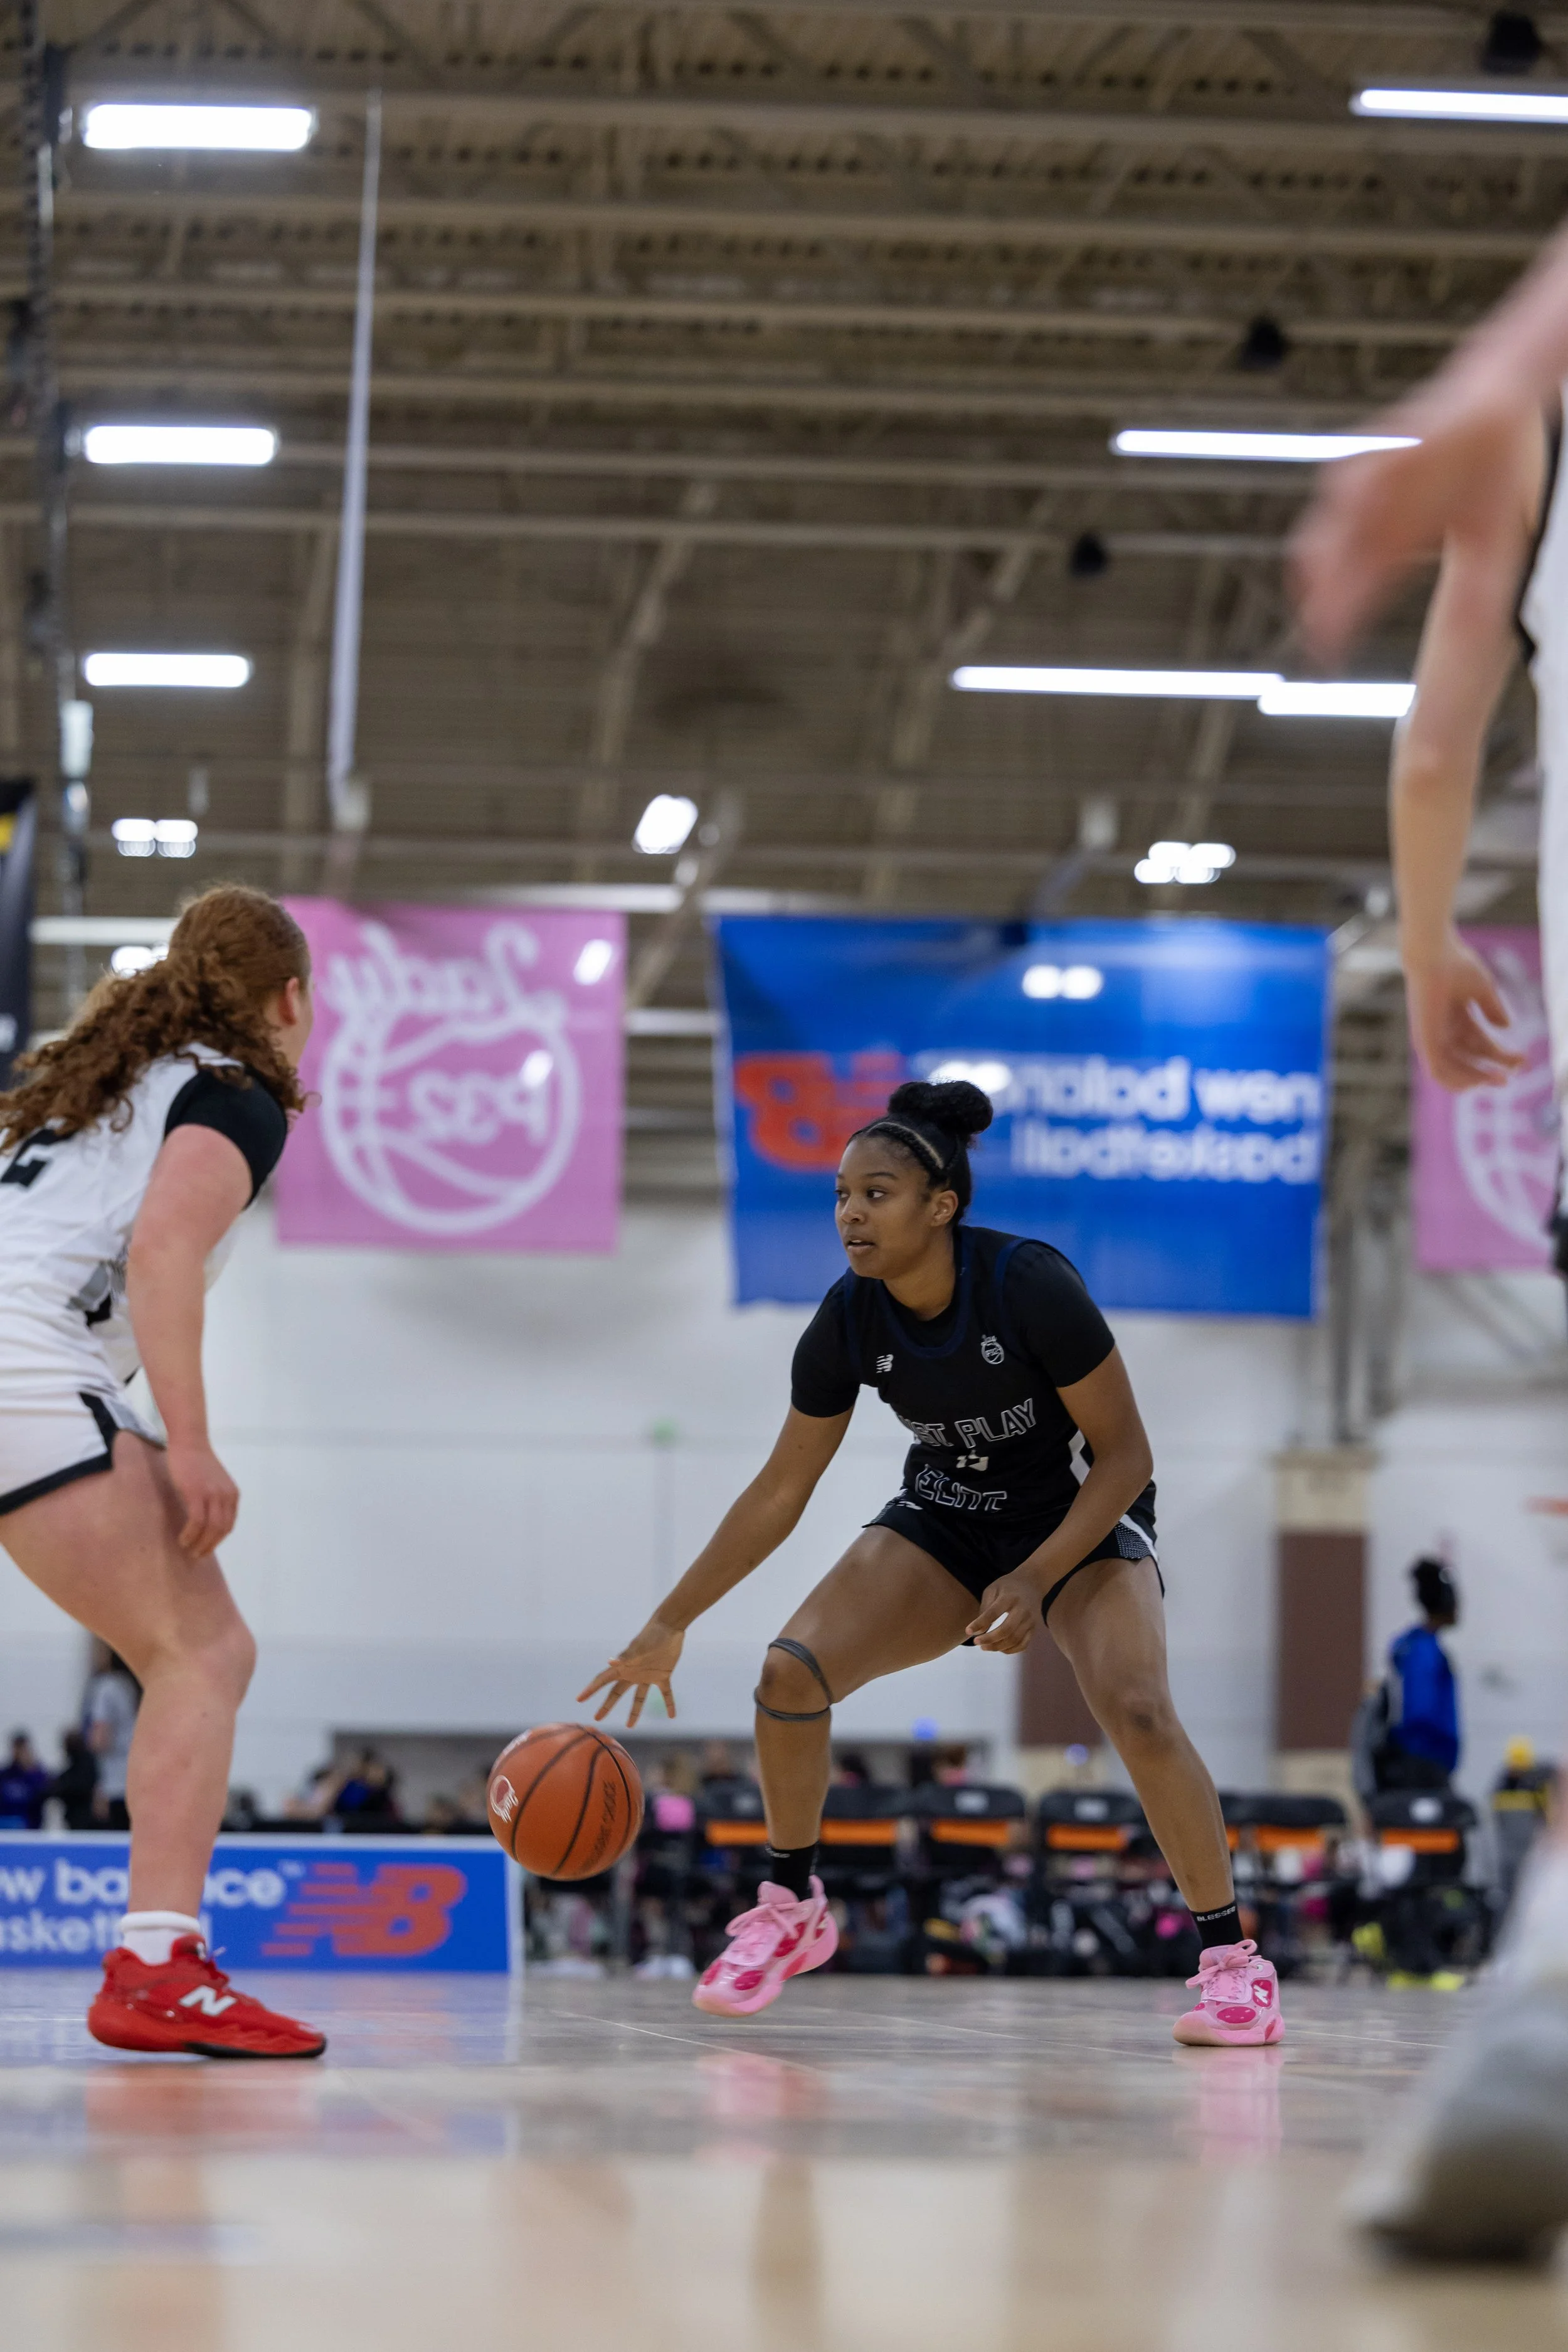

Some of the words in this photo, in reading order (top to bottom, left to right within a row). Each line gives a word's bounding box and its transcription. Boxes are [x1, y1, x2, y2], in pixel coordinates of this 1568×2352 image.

[954, 1398, 1037, 1449] PLAY
[260, 1863, 469, 1957] NB
[1197, 1906, 1236, 1922] BLESSED
[177, 1983, 237, 2017] N
